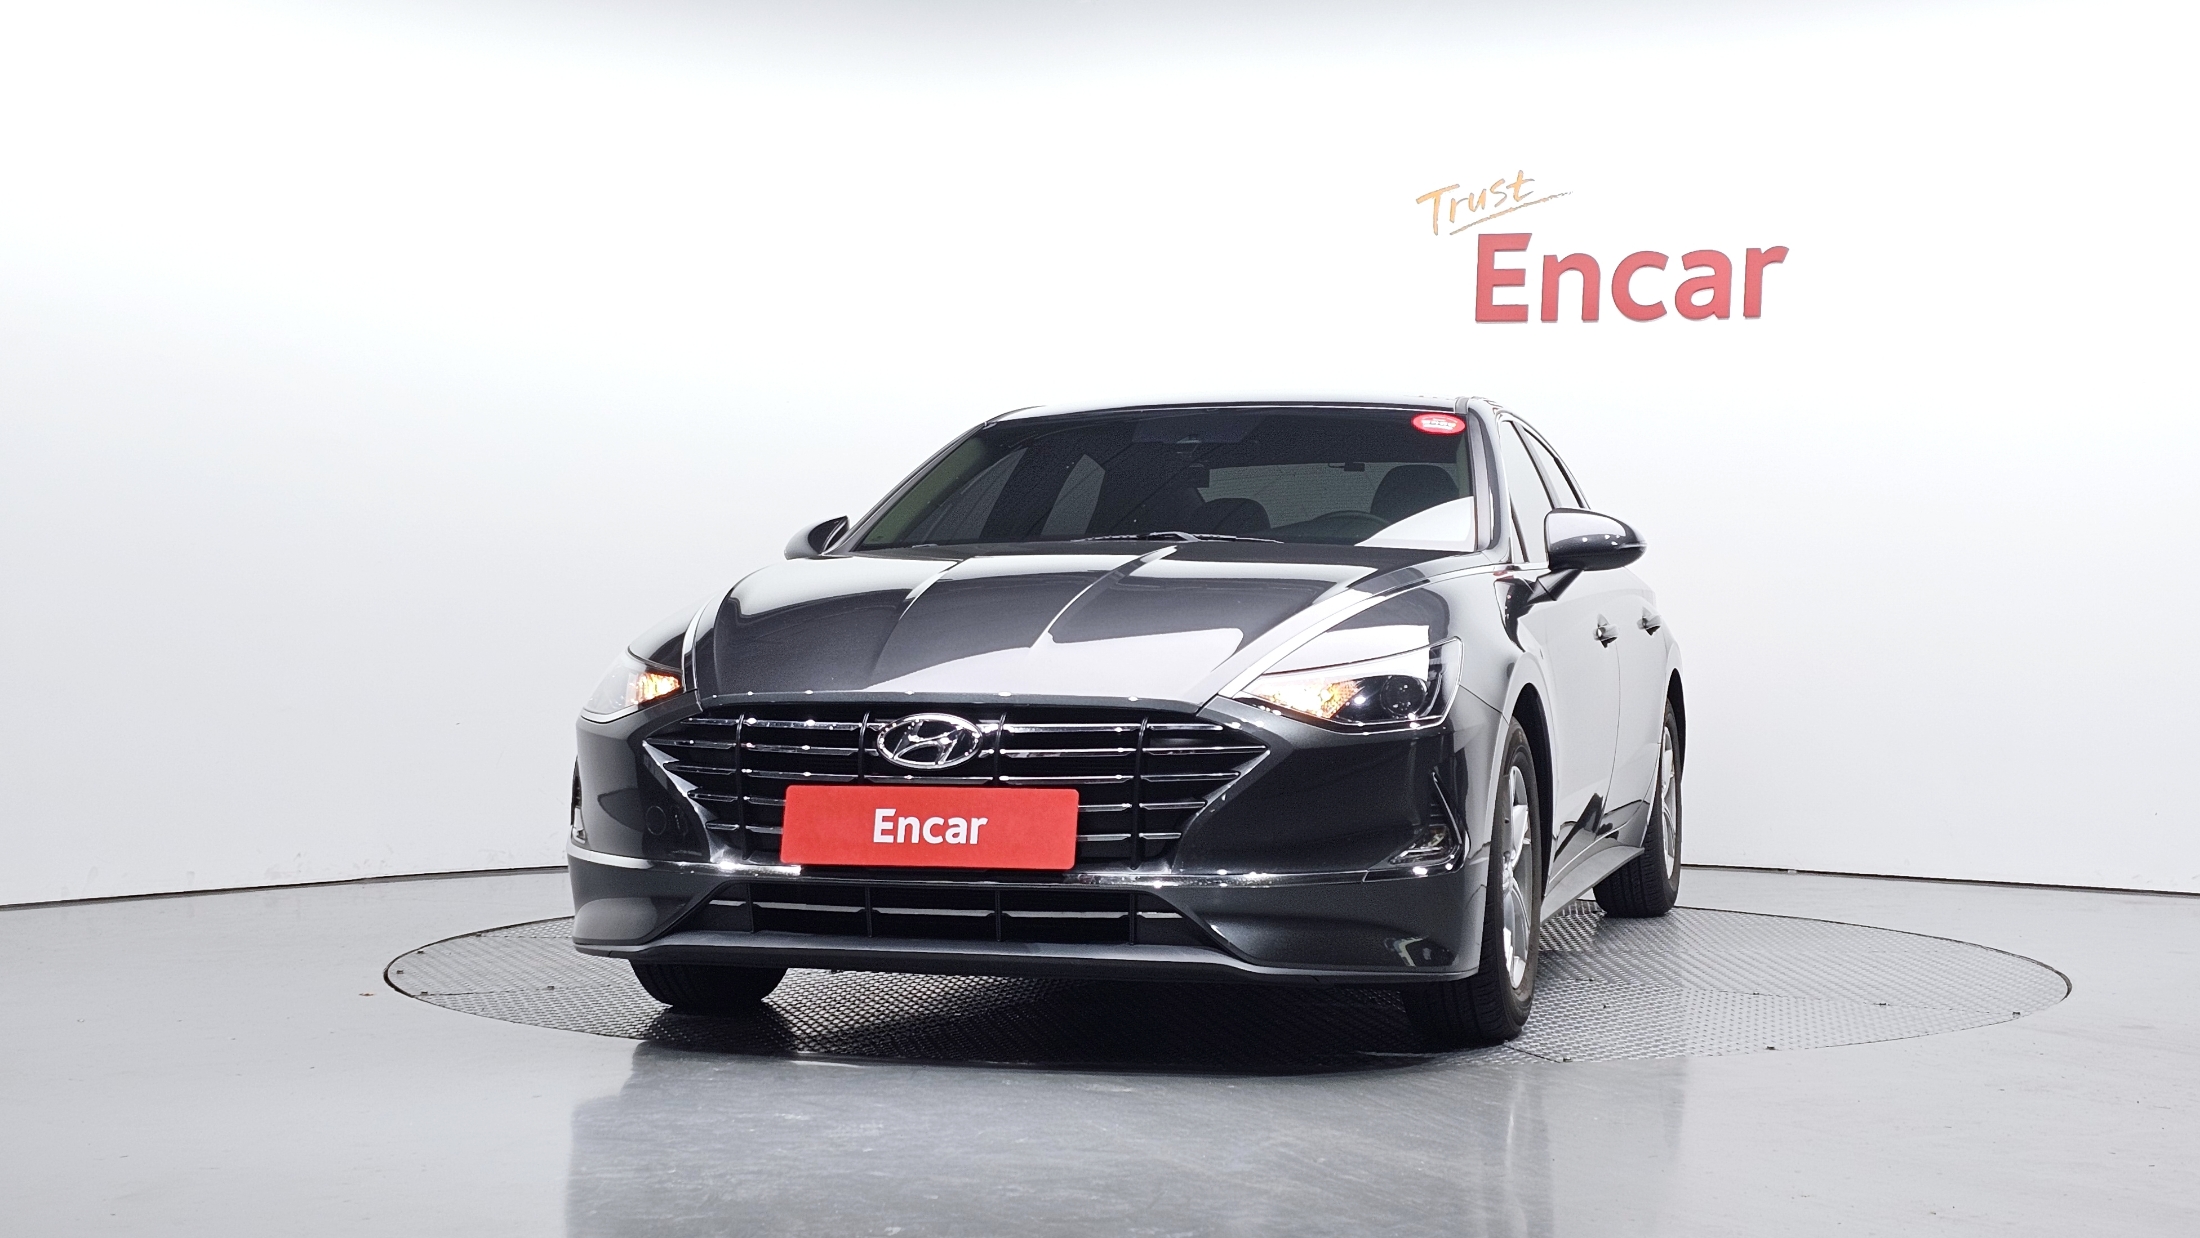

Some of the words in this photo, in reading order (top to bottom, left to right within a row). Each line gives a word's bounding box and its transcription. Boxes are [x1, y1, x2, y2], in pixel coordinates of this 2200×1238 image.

[1416, 170, 1536, 236] Trust
[1475, 232, 1789, 323] Encar
[872, 808, 989, 845] Encar
